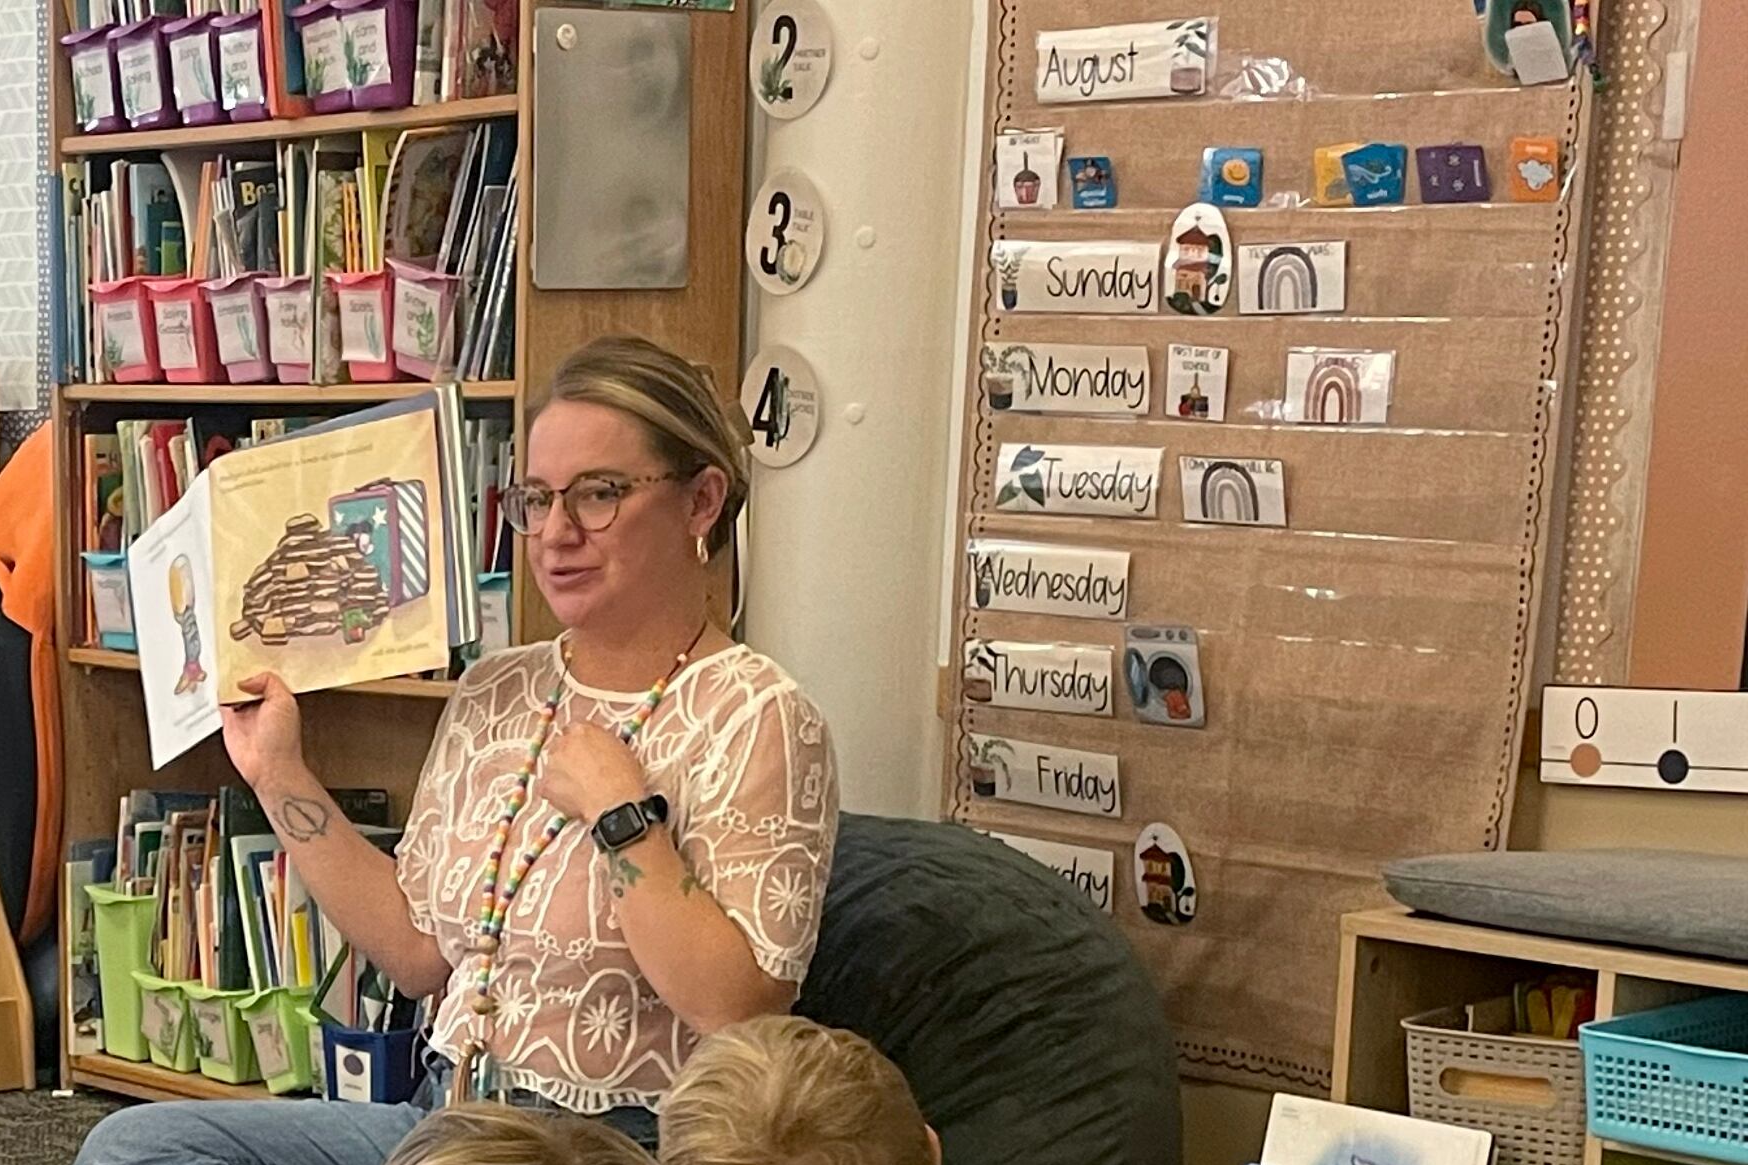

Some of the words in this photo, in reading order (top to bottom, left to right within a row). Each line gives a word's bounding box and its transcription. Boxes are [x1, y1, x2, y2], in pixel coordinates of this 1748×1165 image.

[771, 14, 797, 99] 2
[1042, 41, 1138, 97] August
[760, 191, 791, 274] 3
[1046, 256, 1152, 309] Sunday
[752, 367, 779, 447] 4
[1027, 356, 1144, 408] Monday
[1043, 457, 1153, 512] Tuesday
[969, 552, 1125, 615] Wednesday
[993, 653, 1108, 711] Thursday
[1575, 697, 1598, 739] 0
[1037, 755, 1116, 813] Friday
